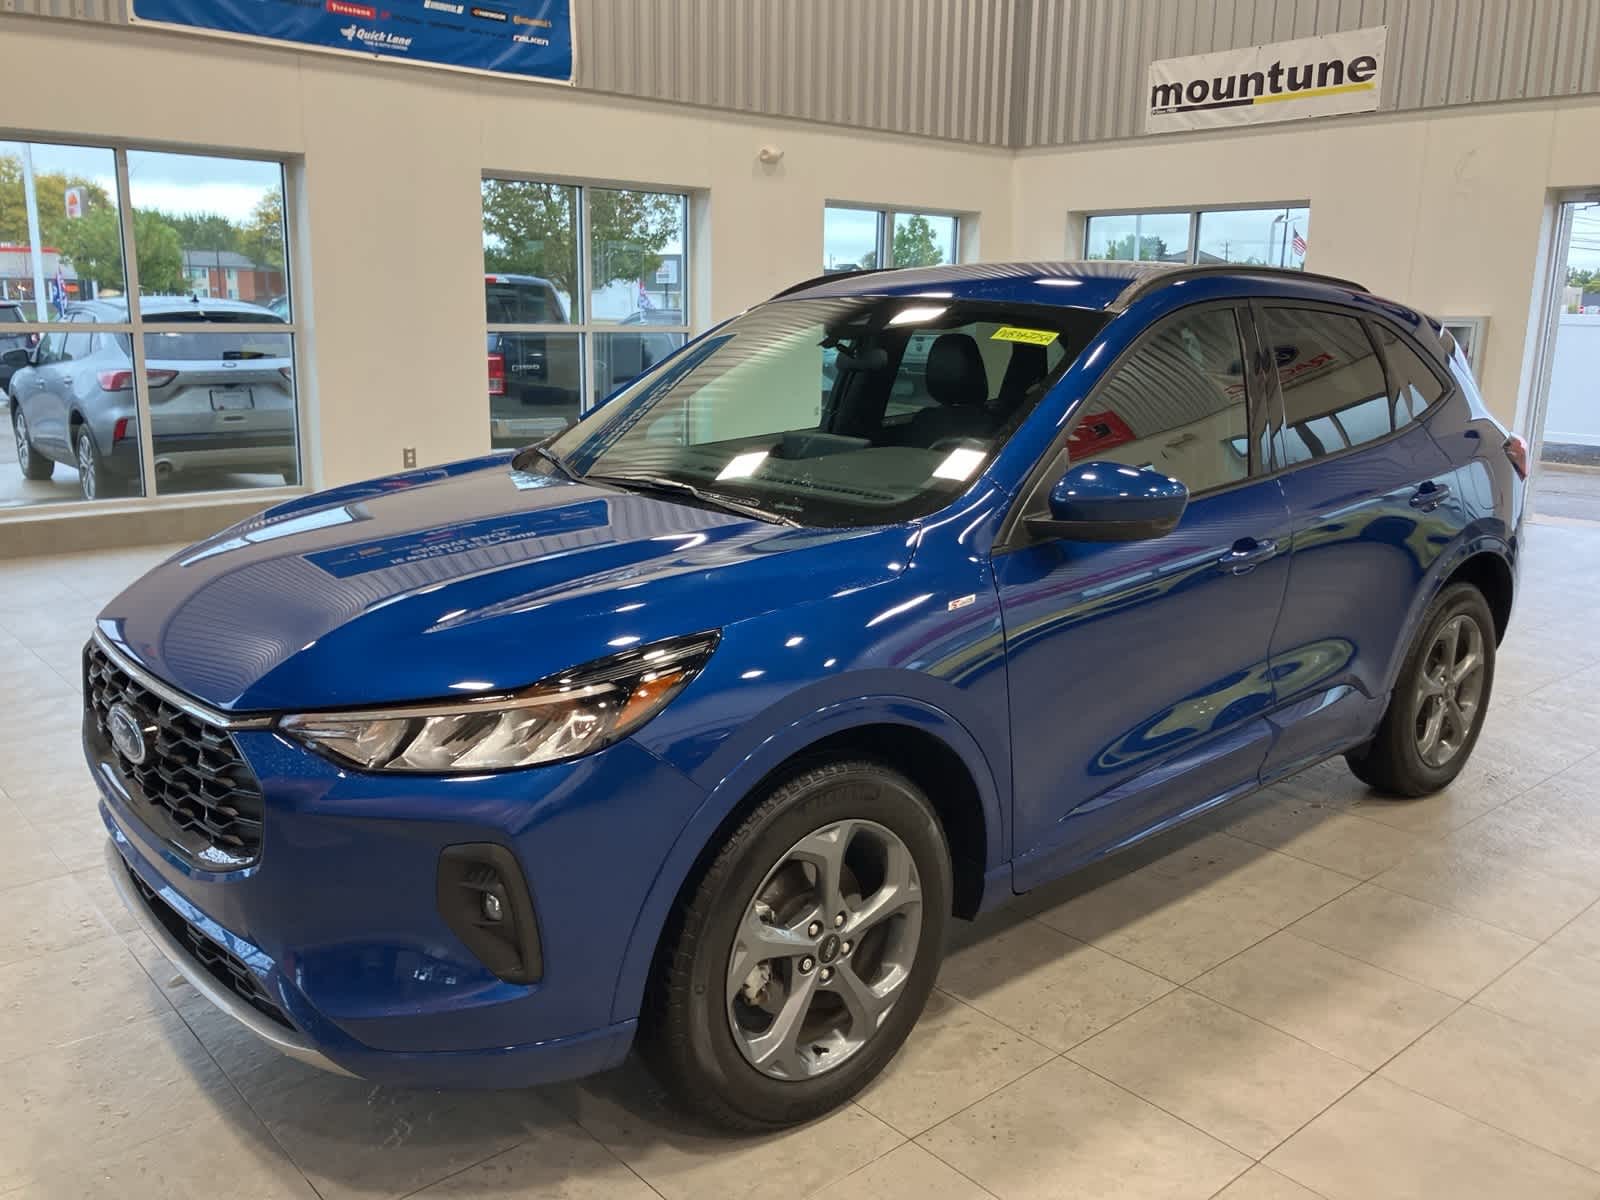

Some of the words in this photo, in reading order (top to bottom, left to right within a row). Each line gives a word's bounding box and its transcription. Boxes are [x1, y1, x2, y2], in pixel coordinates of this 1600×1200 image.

[356, 28, 387, 41] Quick
[386, 33, 412, 46] Lane
[1151, 55, 1377, 108] mountune
